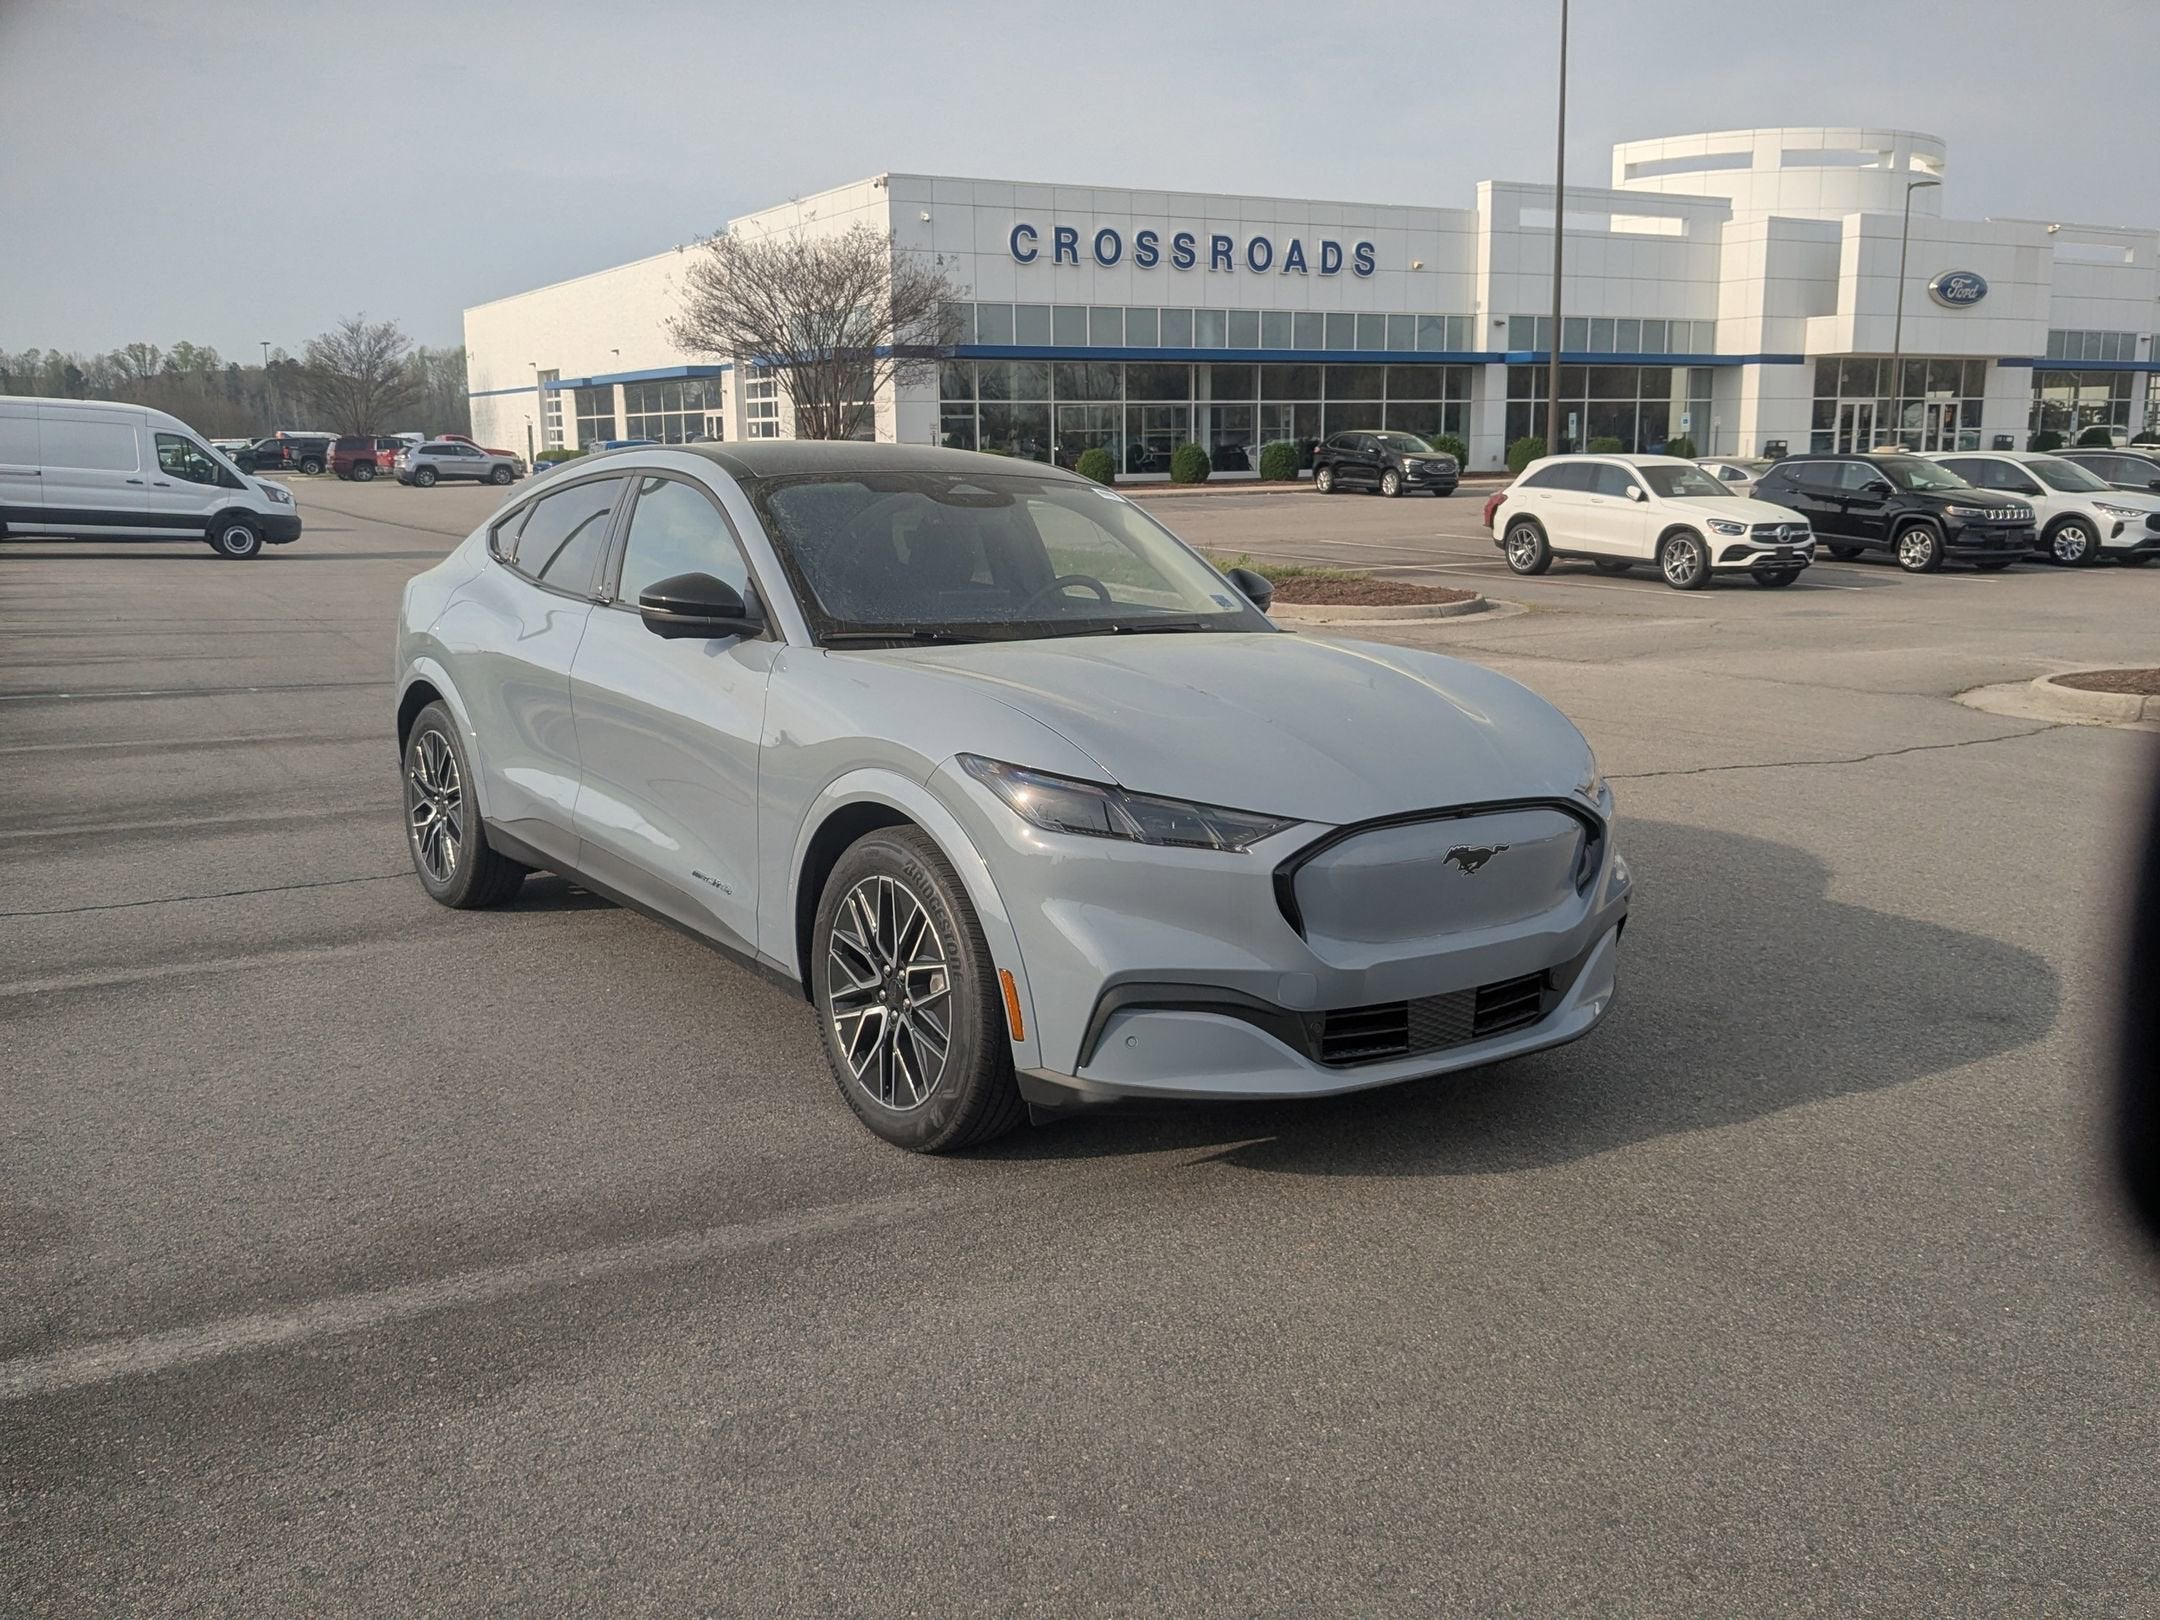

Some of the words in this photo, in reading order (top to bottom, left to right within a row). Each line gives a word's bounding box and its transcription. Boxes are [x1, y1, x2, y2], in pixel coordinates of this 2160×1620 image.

[1009, 224, 1376, 278] CROSSROADS
[1947, 277, 1980, 299] Ford
[902, 859, 963, 981] BRIDGESTONE
